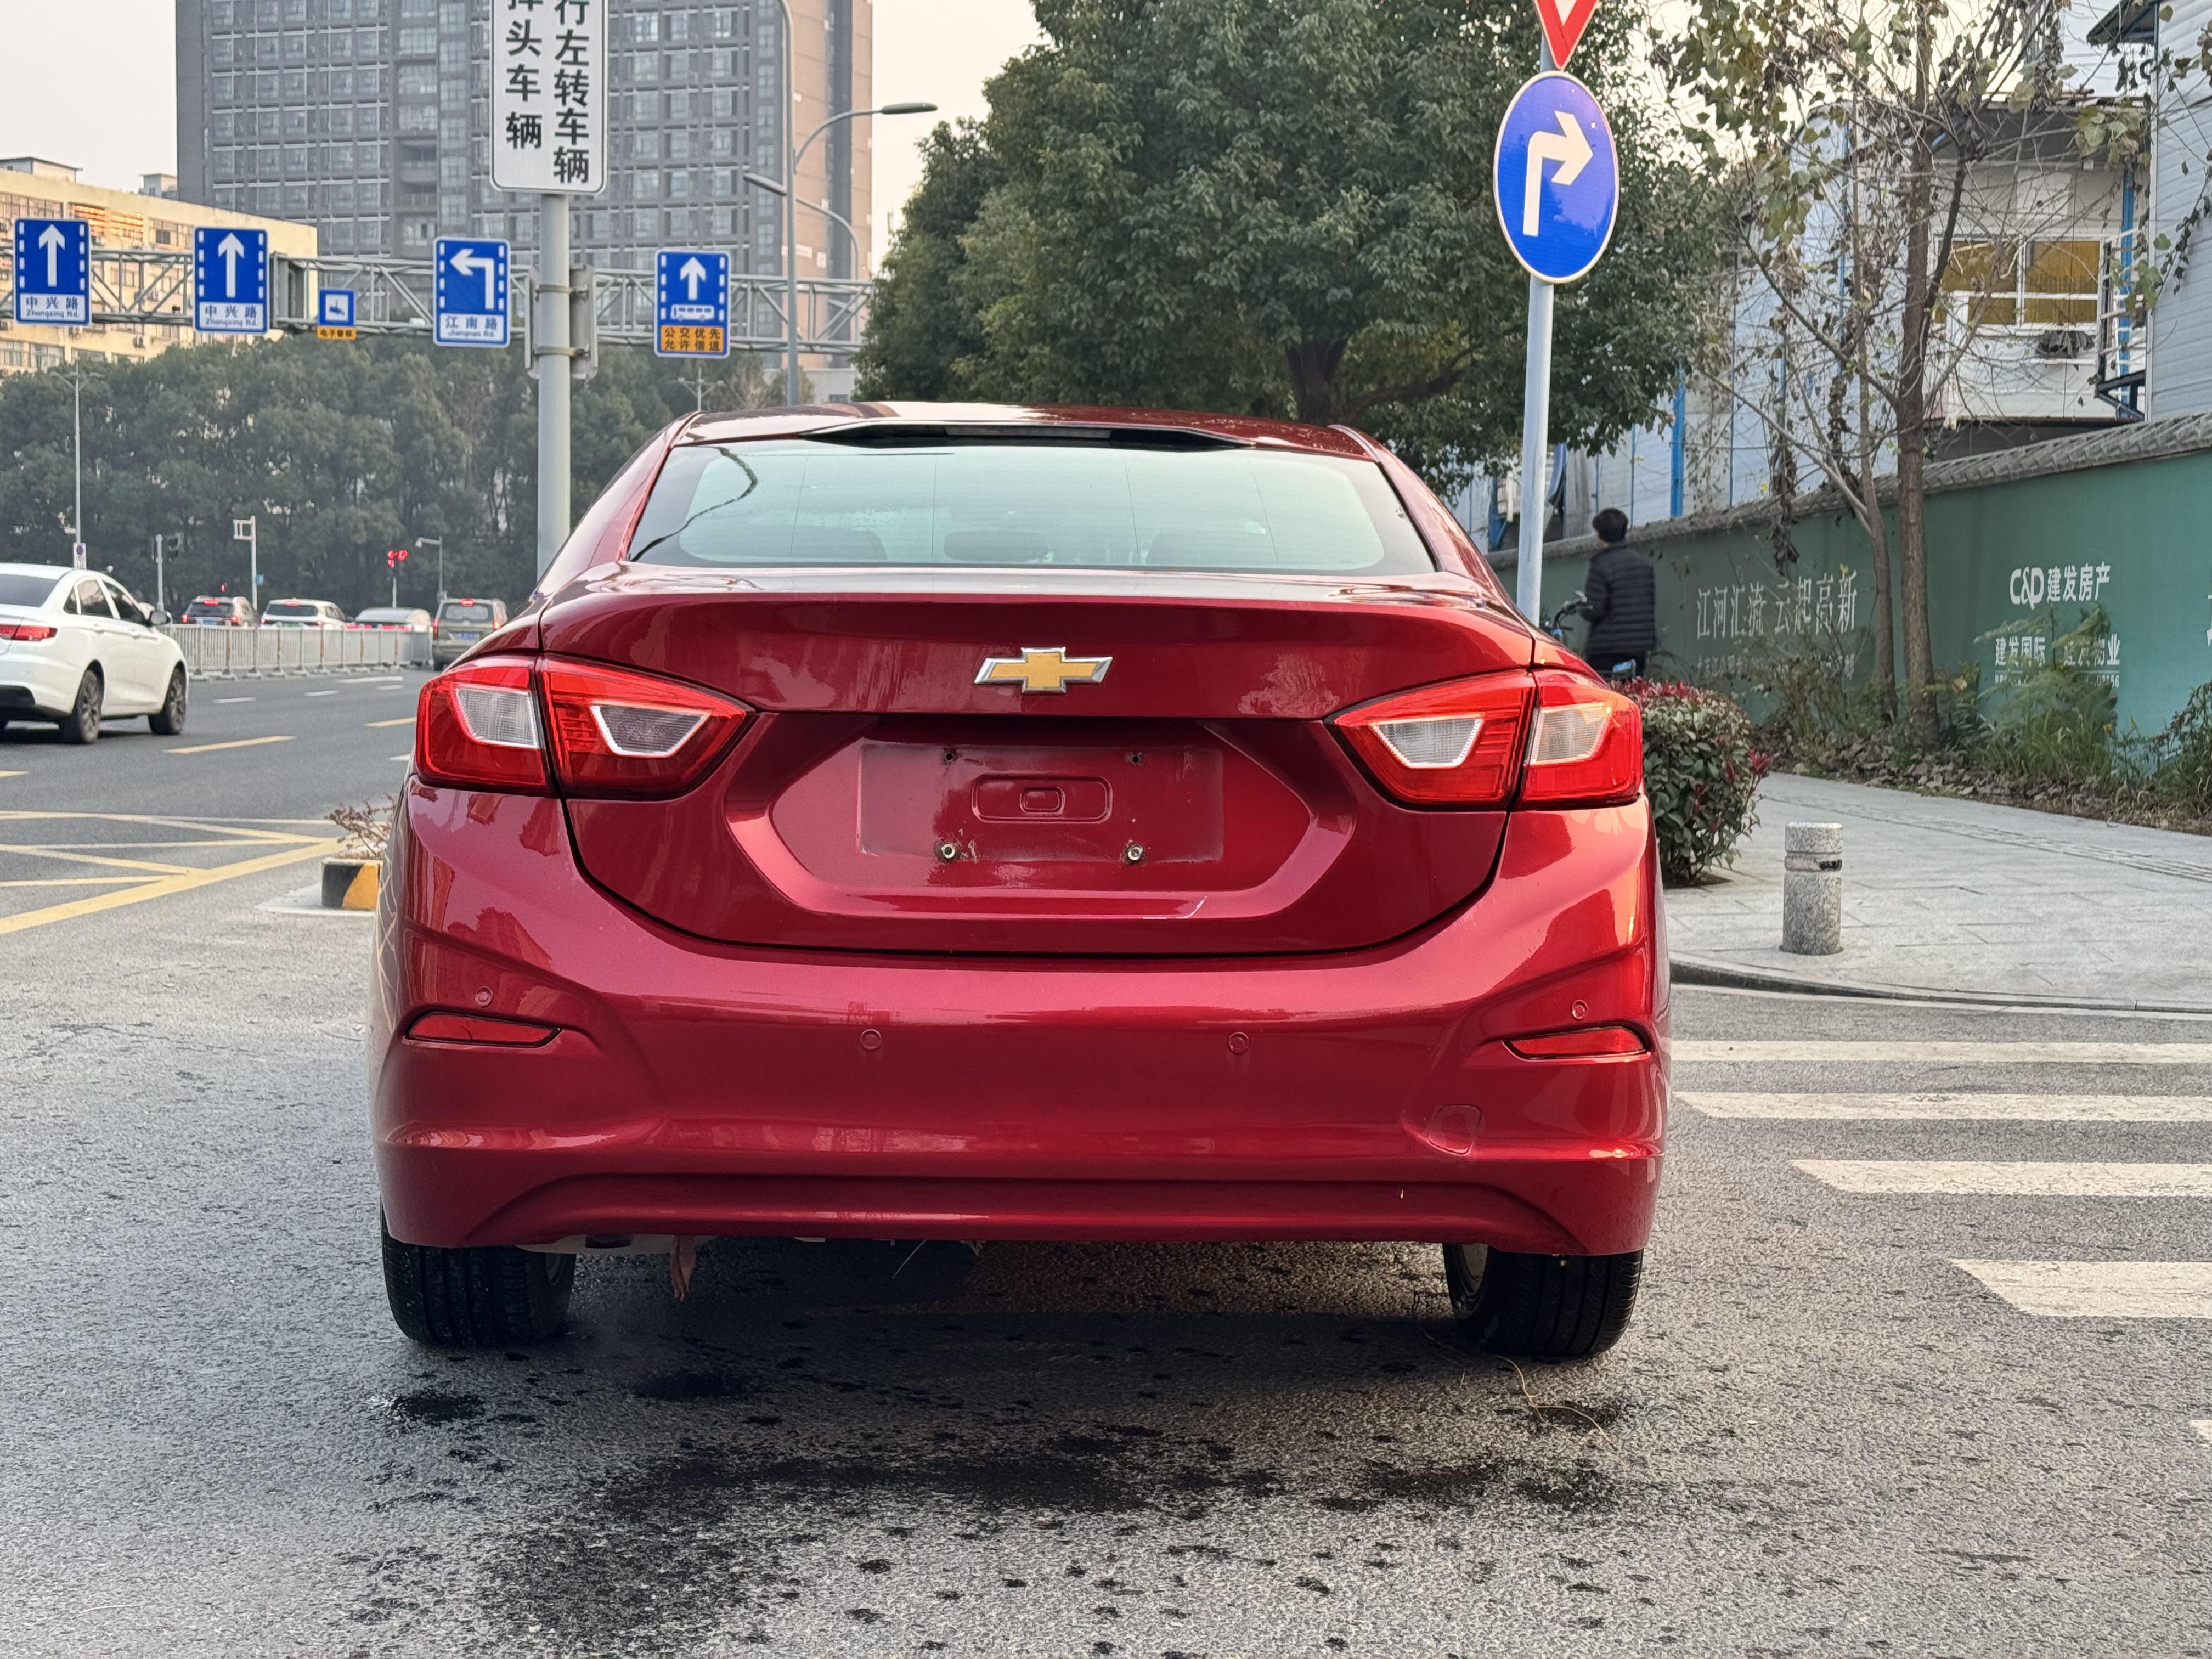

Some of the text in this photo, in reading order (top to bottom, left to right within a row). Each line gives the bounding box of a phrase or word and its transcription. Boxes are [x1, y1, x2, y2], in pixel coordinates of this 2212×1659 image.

[26, 296, 78, 310] 中兴路
[205, 304, 257, 319] 中兴路
[664, 326, 721, 339] 公交优先
[2046, 561, 2111, 603] 建发房产
